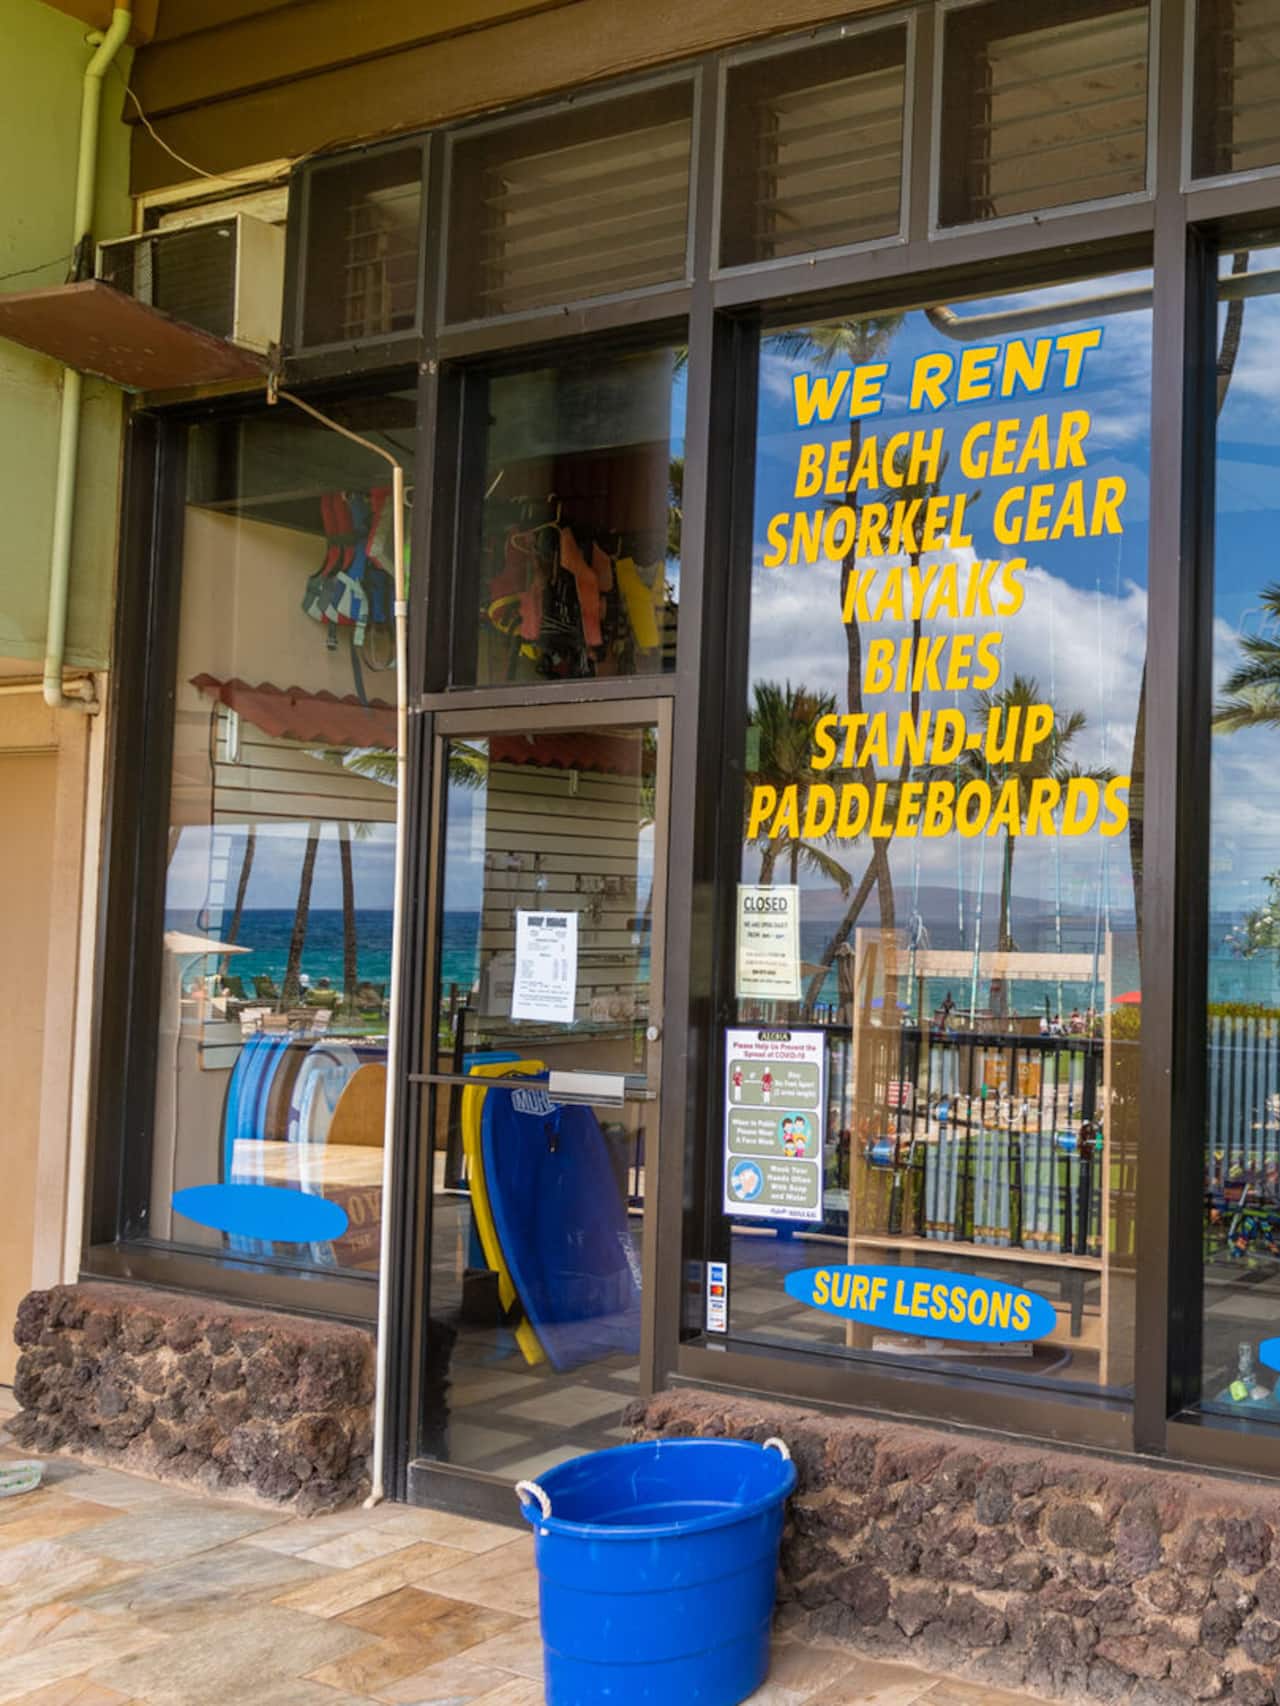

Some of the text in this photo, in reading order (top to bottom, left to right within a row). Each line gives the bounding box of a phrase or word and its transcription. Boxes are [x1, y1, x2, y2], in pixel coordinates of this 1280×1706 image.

[792, 328, 1102, 427] WE RENT
[794, 410, 1090, 498] BEACH GEAR
[763, 476, 1127, 568] SNORKEL GEAR
[841, 558, 1027, 624] KAYAKS
[863, 632, 1003, 694] BIKES
[811, 703, 1055, 770] STAND-UP
[746, 775, 1131, 839] PADDLEBOARDS
[743, 896, 788, 912] CLOSED
[812, 1270, 1032, 1331] SURF LESSONS
